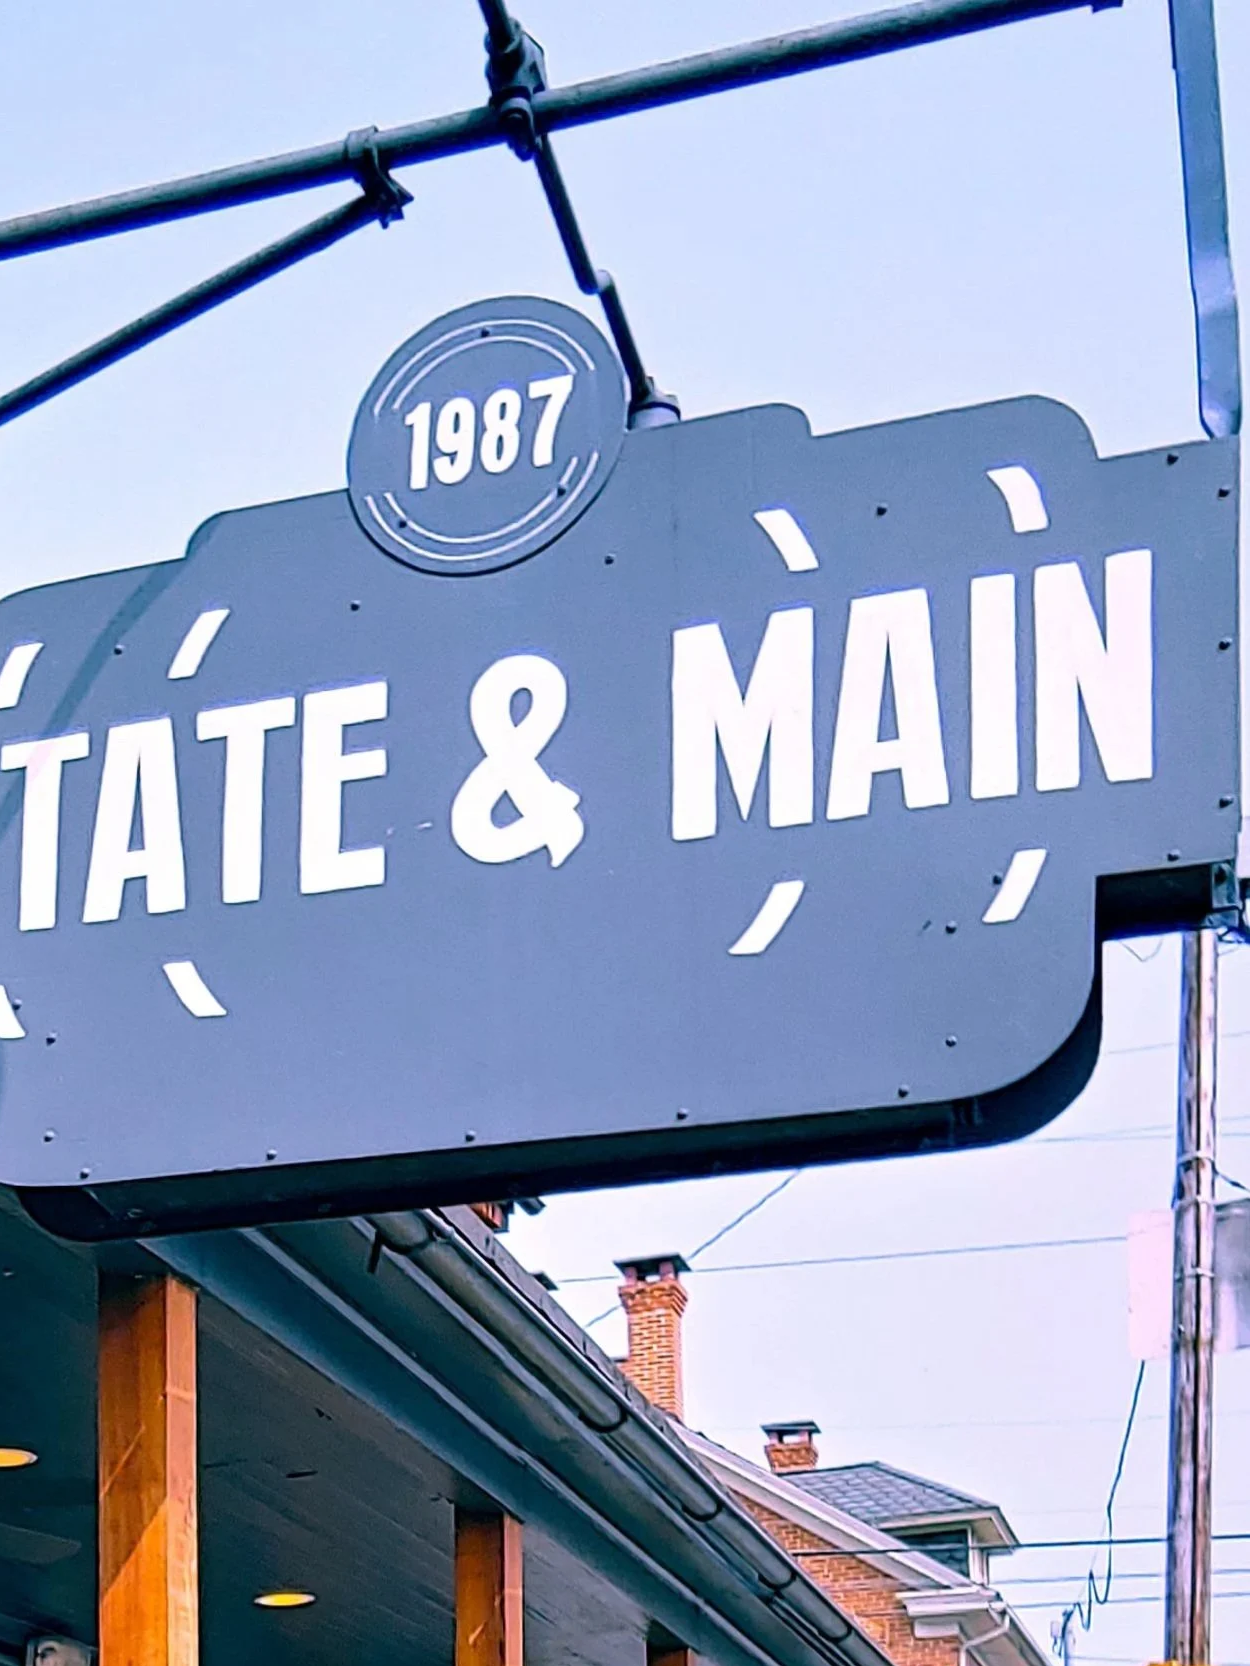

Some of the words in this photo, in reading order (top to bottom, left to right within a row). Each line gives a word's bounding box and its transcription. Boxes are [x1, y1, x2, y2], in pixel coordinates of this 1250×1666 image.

[404, 373, 574, 491] 1987
[452, 654, 585, 868] &
[671, 549, 1153, 841] MAIN
